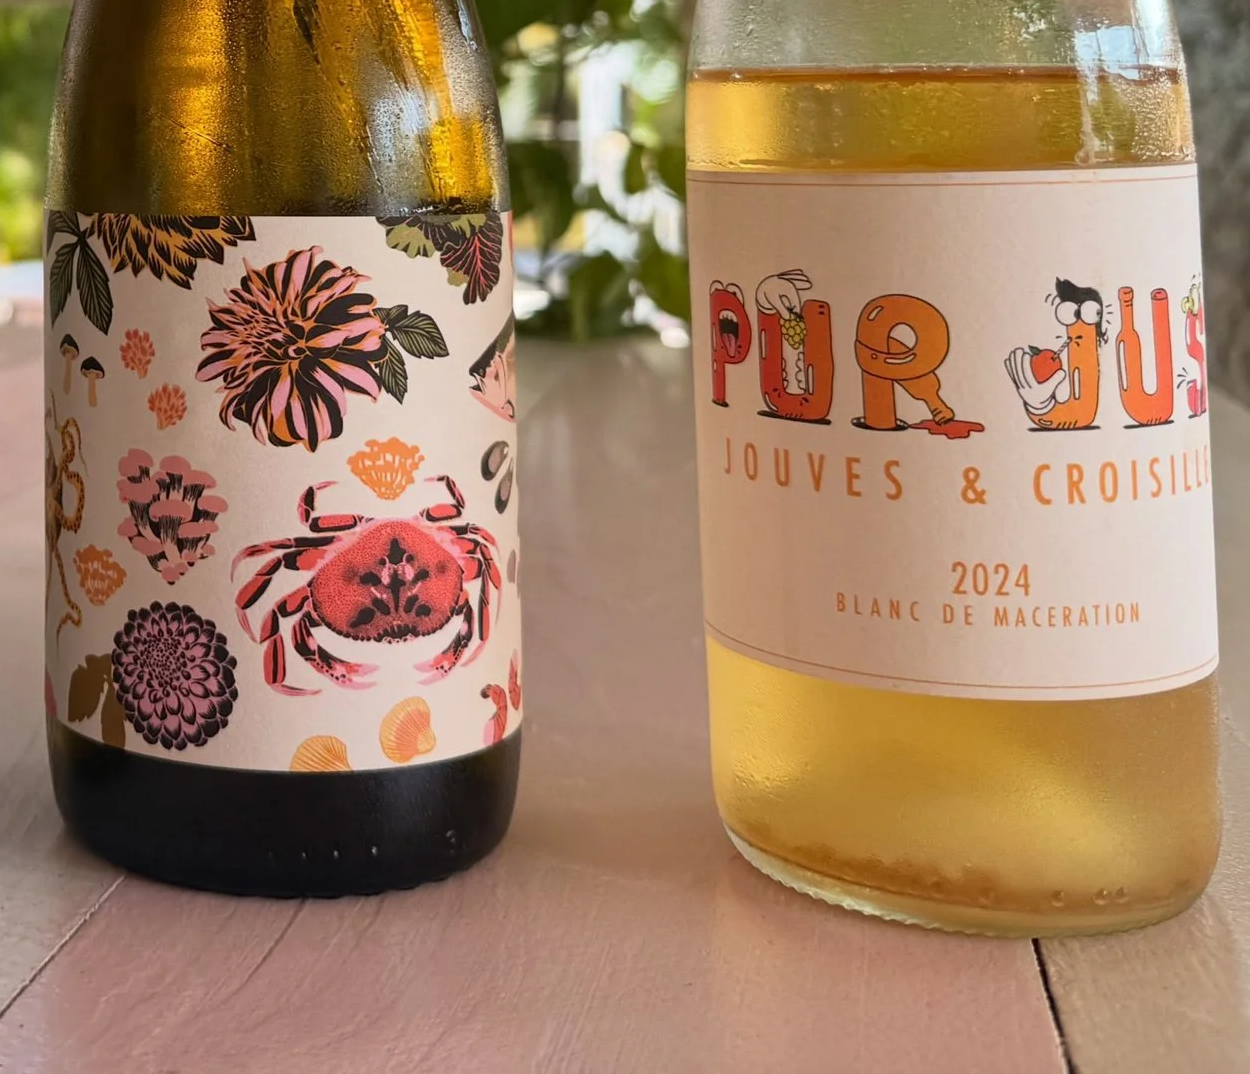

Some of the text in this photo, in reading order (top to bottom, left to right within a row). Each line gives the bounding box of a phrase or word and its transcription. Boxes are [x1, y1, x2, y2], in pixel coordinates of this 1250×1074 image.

[709, 274, 956, 430] PUR
[724, 437, 903, 501] JOUVES
[960, 466, 987, 505] &
[951, 561, 1031, 596] 2024
[836, 591, 1140, 627] BLANC DE MACERATION
